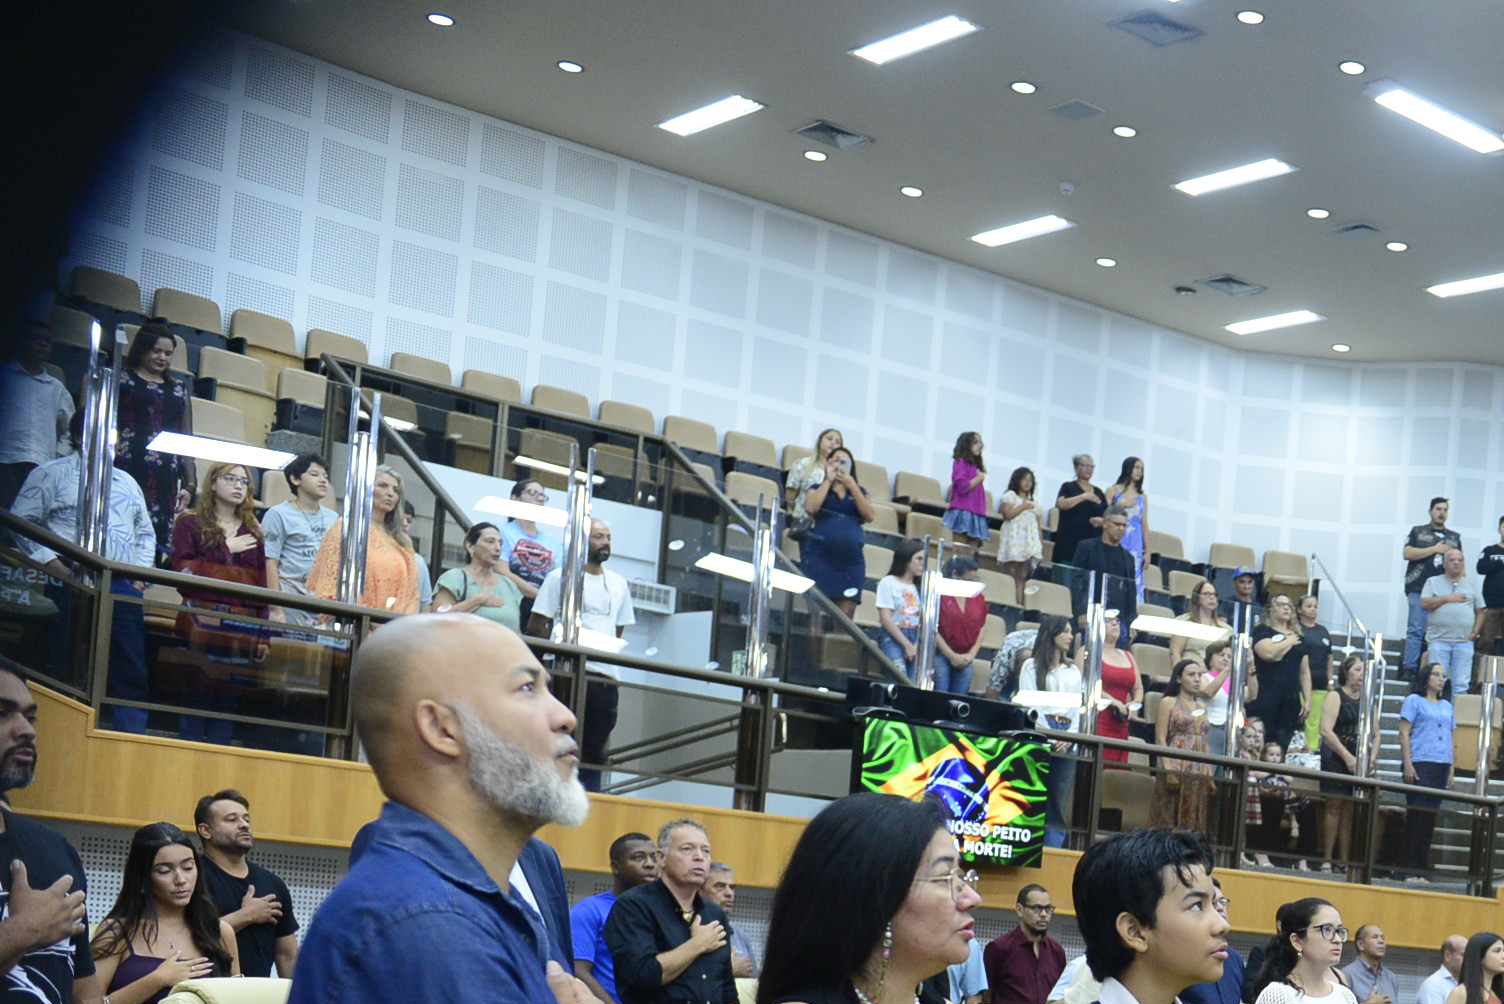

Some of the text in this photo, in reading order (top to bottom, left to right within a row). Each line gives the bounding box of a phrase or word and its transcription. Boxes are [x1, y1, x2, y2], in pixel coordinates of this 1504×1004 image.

[946, 819, 1032, 843] NOSSO PEITO
[963, 840, 1013, 858] MORTE!
